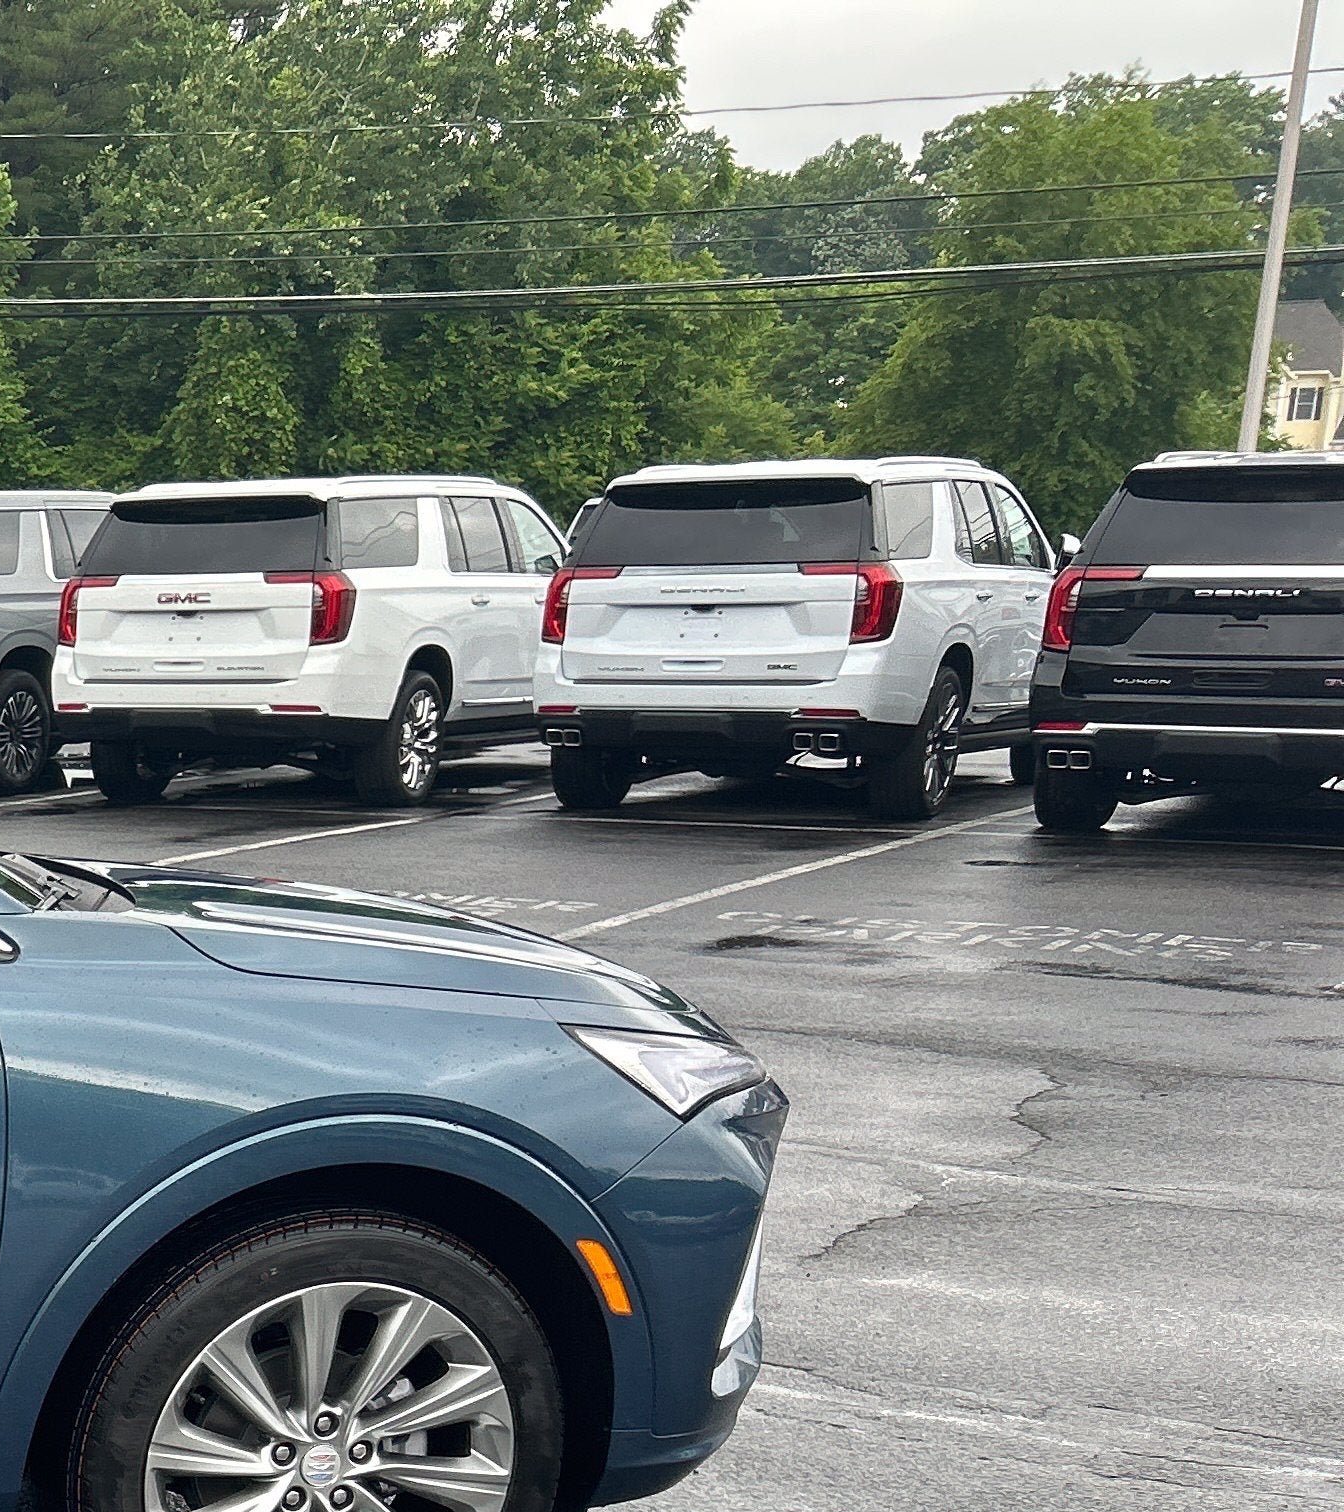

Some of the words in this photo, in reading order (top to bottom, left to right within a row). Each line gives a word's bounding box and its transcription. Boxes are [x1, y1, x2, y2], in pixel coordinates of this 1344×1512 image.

[660, 584, 746, 594] DENALI
[1193, 589, 1302, 598] DENALI
[157, 592, 211, 605] GMC
[1113, 677, 1173, 686] YUKON
